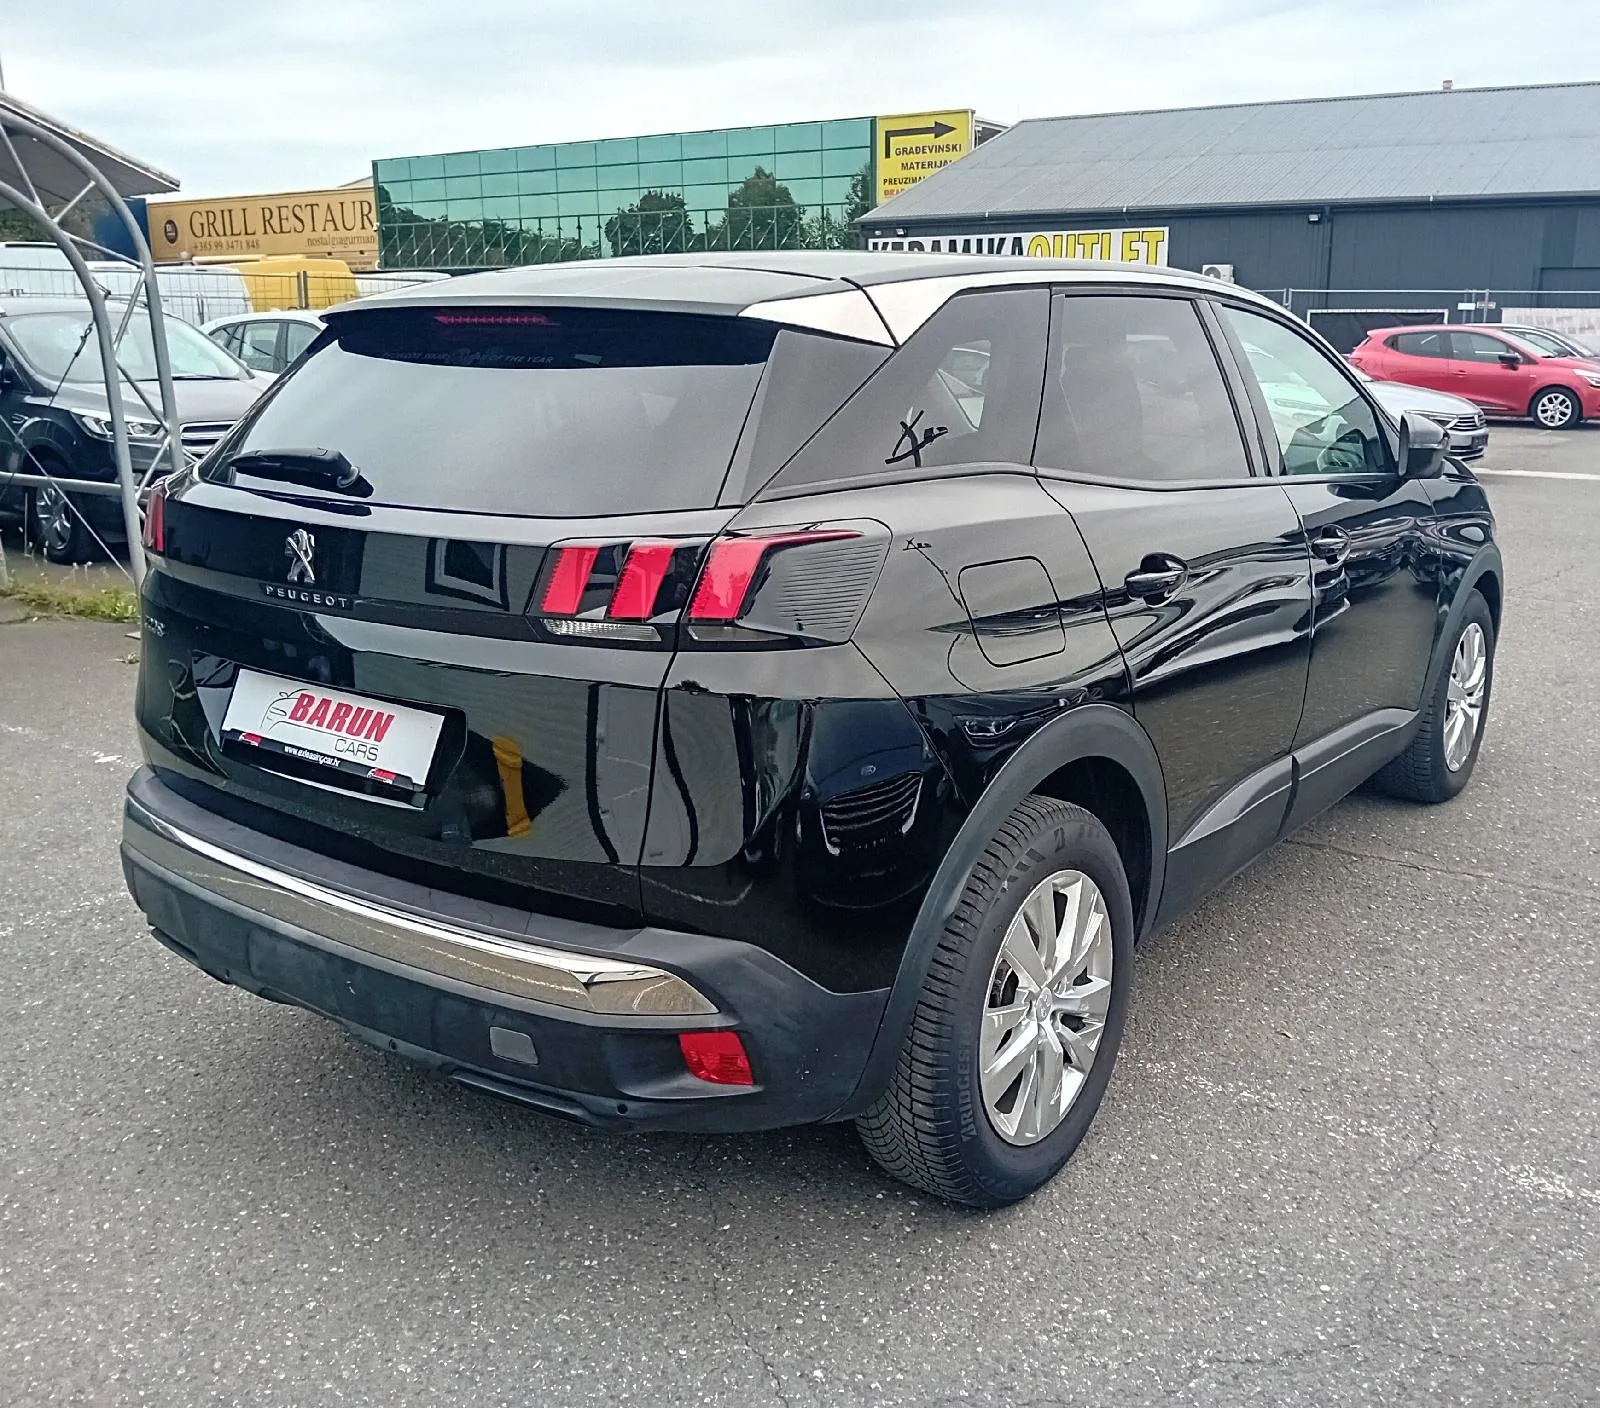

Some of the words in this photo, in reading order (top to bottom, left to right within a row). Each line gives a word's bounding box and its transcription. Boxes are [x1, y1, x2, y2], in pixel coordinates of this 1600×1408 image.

[895, 143, 962, 157] GRAĐEVINSKI
[901, 160, 953, 171] MATERIJA
[883, 176, 926, 186] PREUZIMA
[189, 207, 257, 239] GRILL
[261, 199, 375, 236] RESTAUR
[266, 585, 348, 609] PEUGEOT
[288, 692, 396, 744] BARUN
[334, 738, 379, 762] CARS
